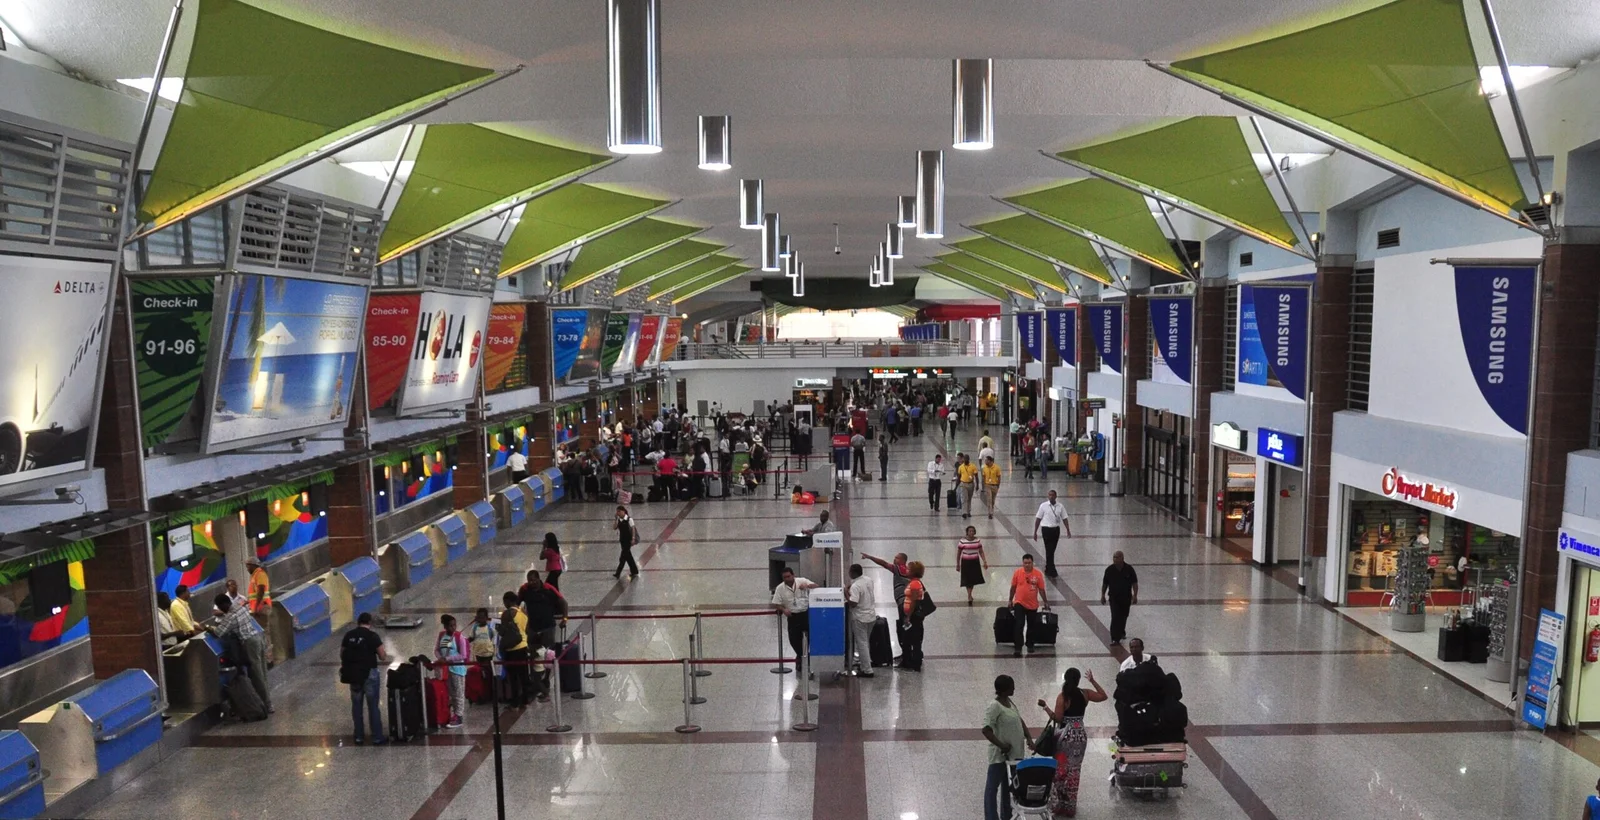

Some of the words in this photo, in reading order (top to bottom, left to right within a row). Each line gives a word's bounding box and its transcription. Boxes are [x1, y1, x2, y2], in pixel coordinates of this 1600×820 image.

[64, 281, 96, 294] DELTA
[143, 297, 198, 308] Check-in
[371, 307, 409, 315] Check-in
[557, 334, 579, 342] 73-78
[1103, 309, 1111, 354] SAMSUNG
[1168, 302, 1179, 358] SAMSUNG
[1277, 293, 1291, 366] SAMSUNG
[1487, 277, 1509, 384] SAMSUNG
[145, 339, 196, 356] 91-96
[372, 335, 407, 346] 85-90
[488, 336, 514, 345] 79-84
[1420, 483, 1455, 510] Market
[1569, 537, 1600, 557] Vimenca
